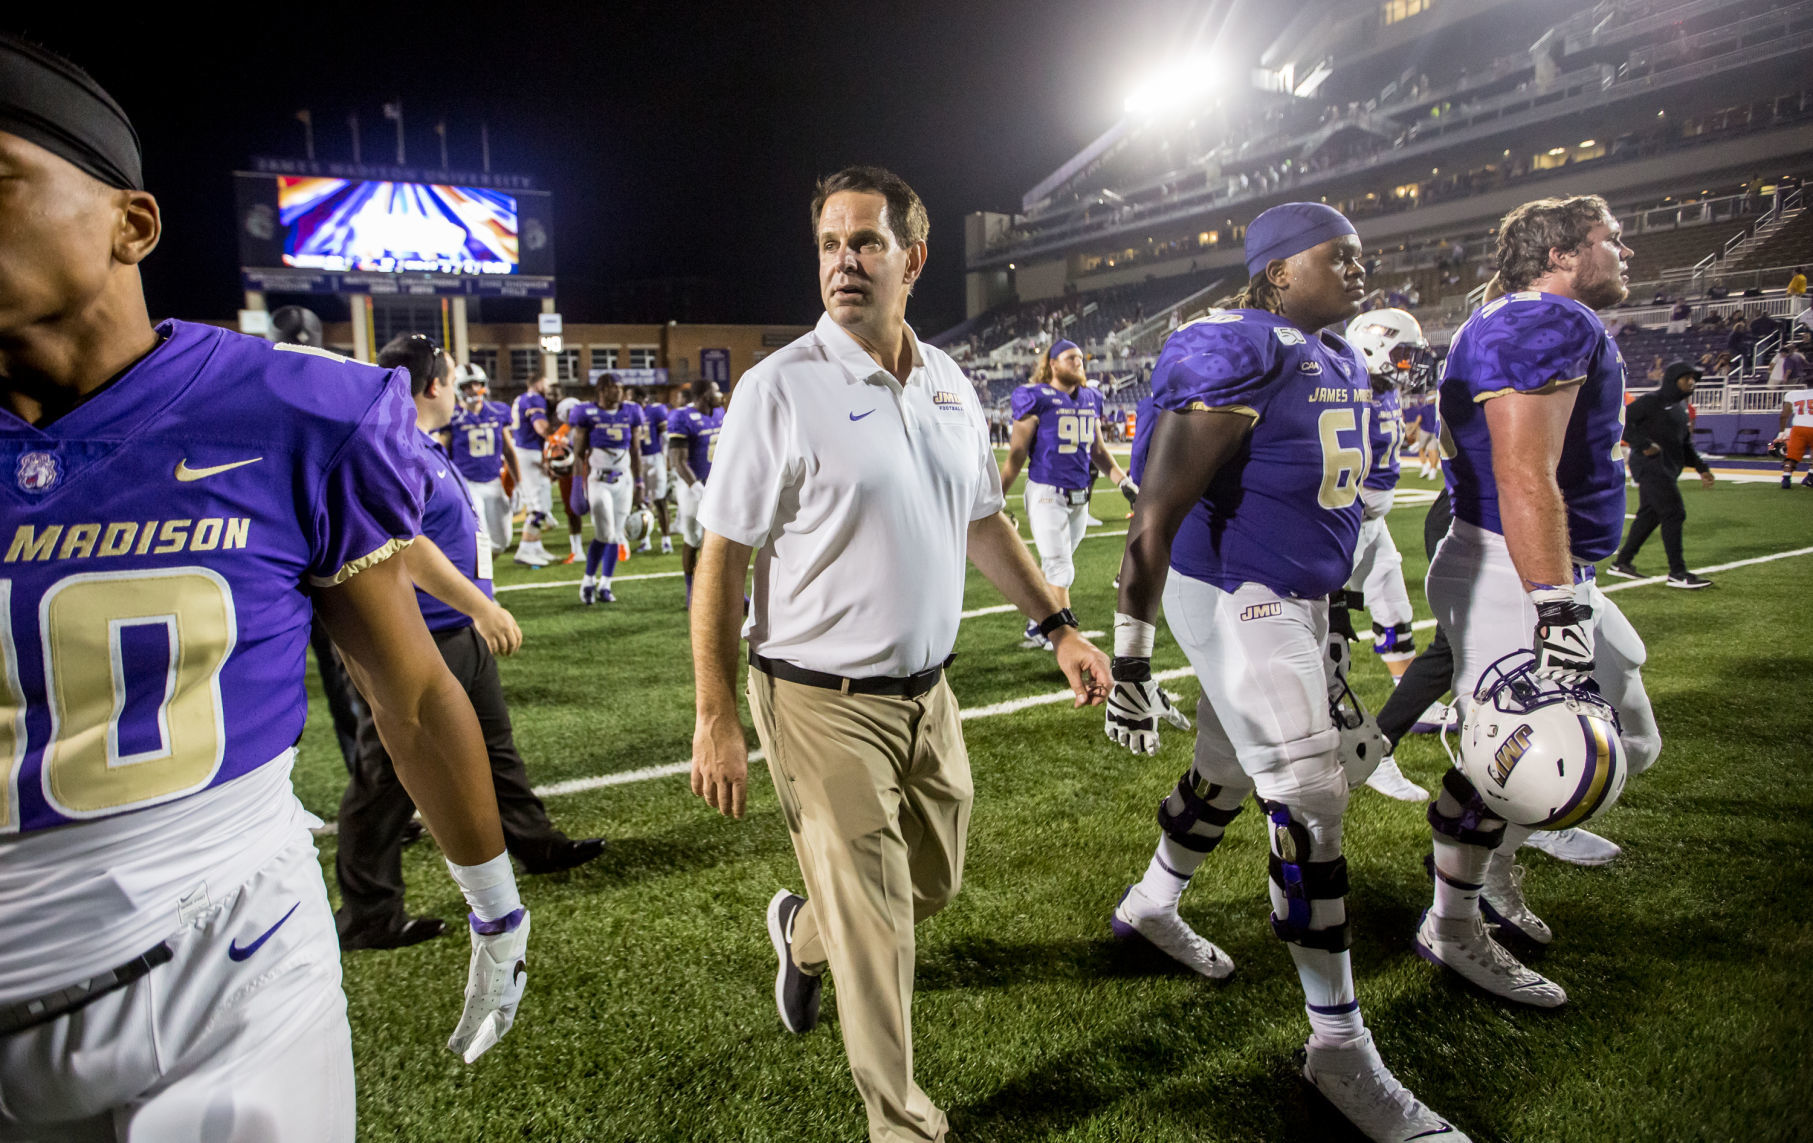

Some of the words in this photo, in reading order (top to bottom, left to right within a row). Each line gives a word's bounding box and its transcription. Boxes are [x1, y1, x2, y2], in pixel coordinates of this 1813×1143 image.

[1301, 361, 1320, 371] CAA
[1308, 387, 1348, 403] JAMES
[468, 427, 495, 457] 61
[1058, 416, 1096, 454] 94
[4, 517, 250, 563] MADISON
[1240, 601, 1282, 622] JMU
[1487, 723, 1534, 789] JMU
